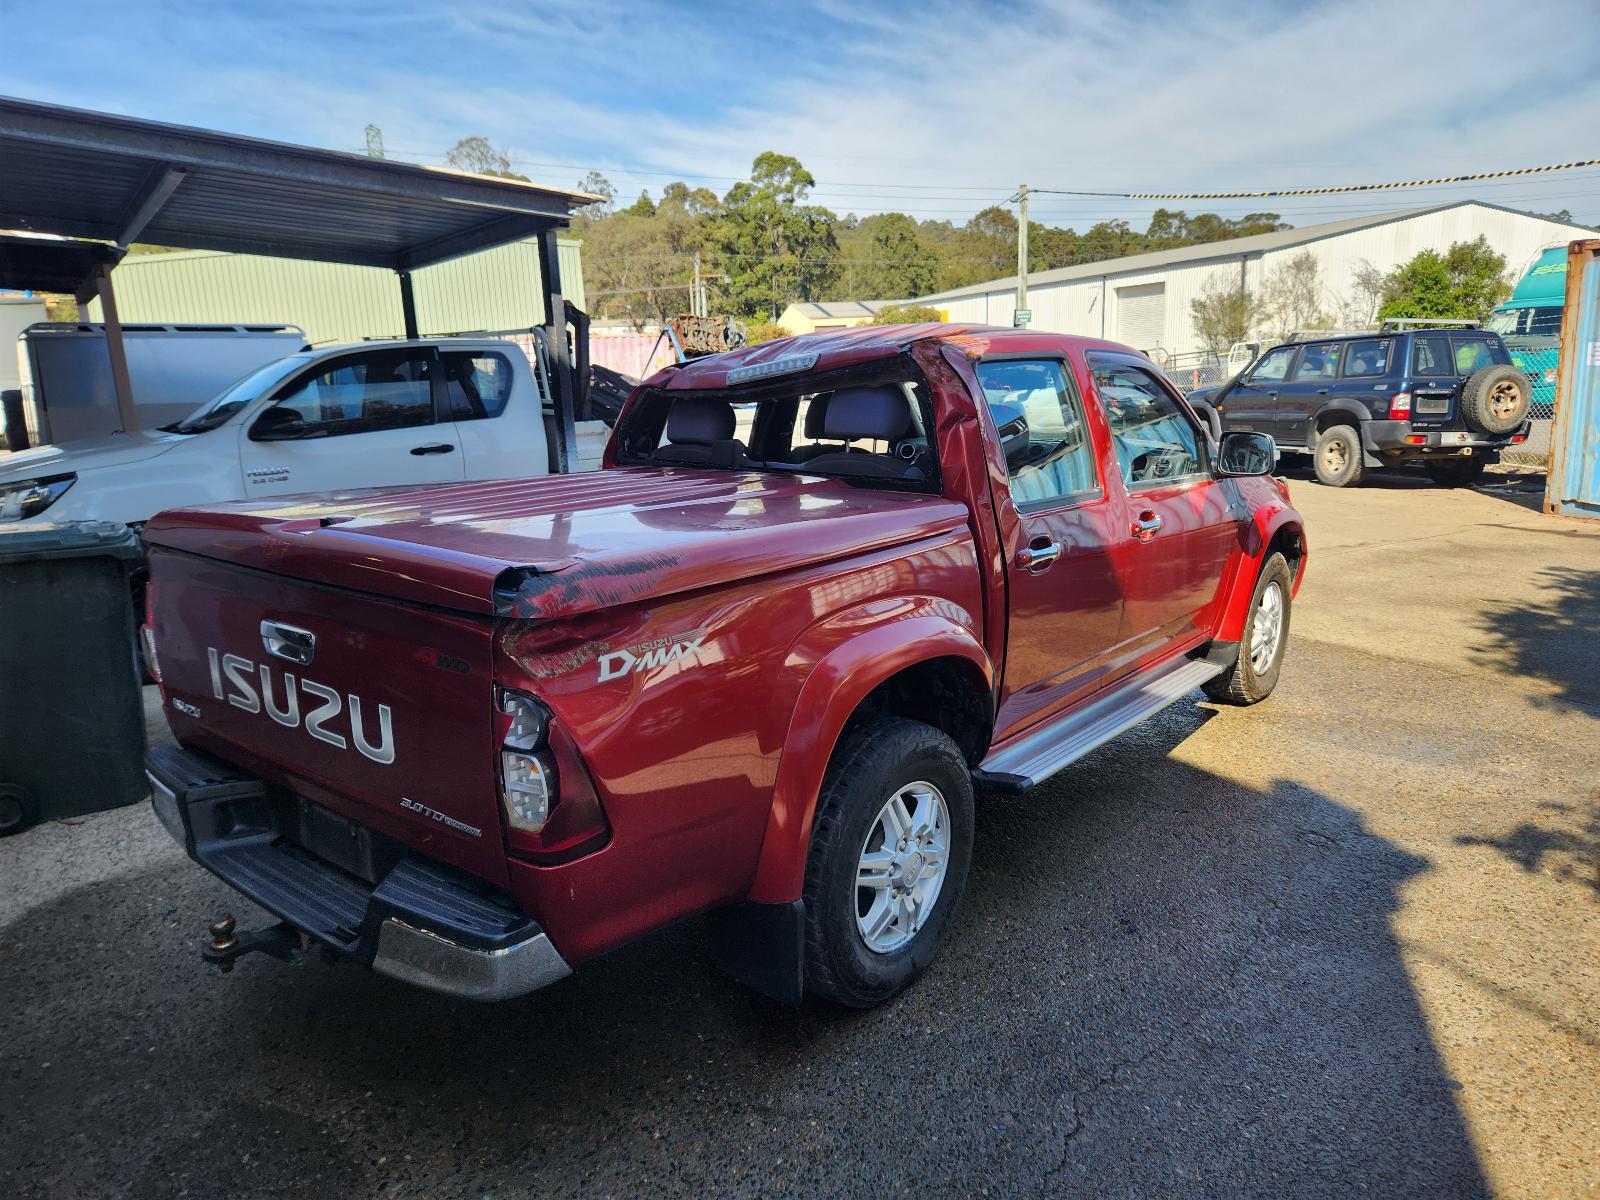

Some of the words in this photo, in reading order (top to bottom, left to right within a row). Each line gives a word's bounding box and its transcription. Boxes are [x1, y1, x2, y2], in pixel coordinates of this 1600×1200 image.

[597, 636, 706, 683] D-MAX
[637, 636, 673, 652] ISUZU
[208, 647, 395, 765] ISUZU
